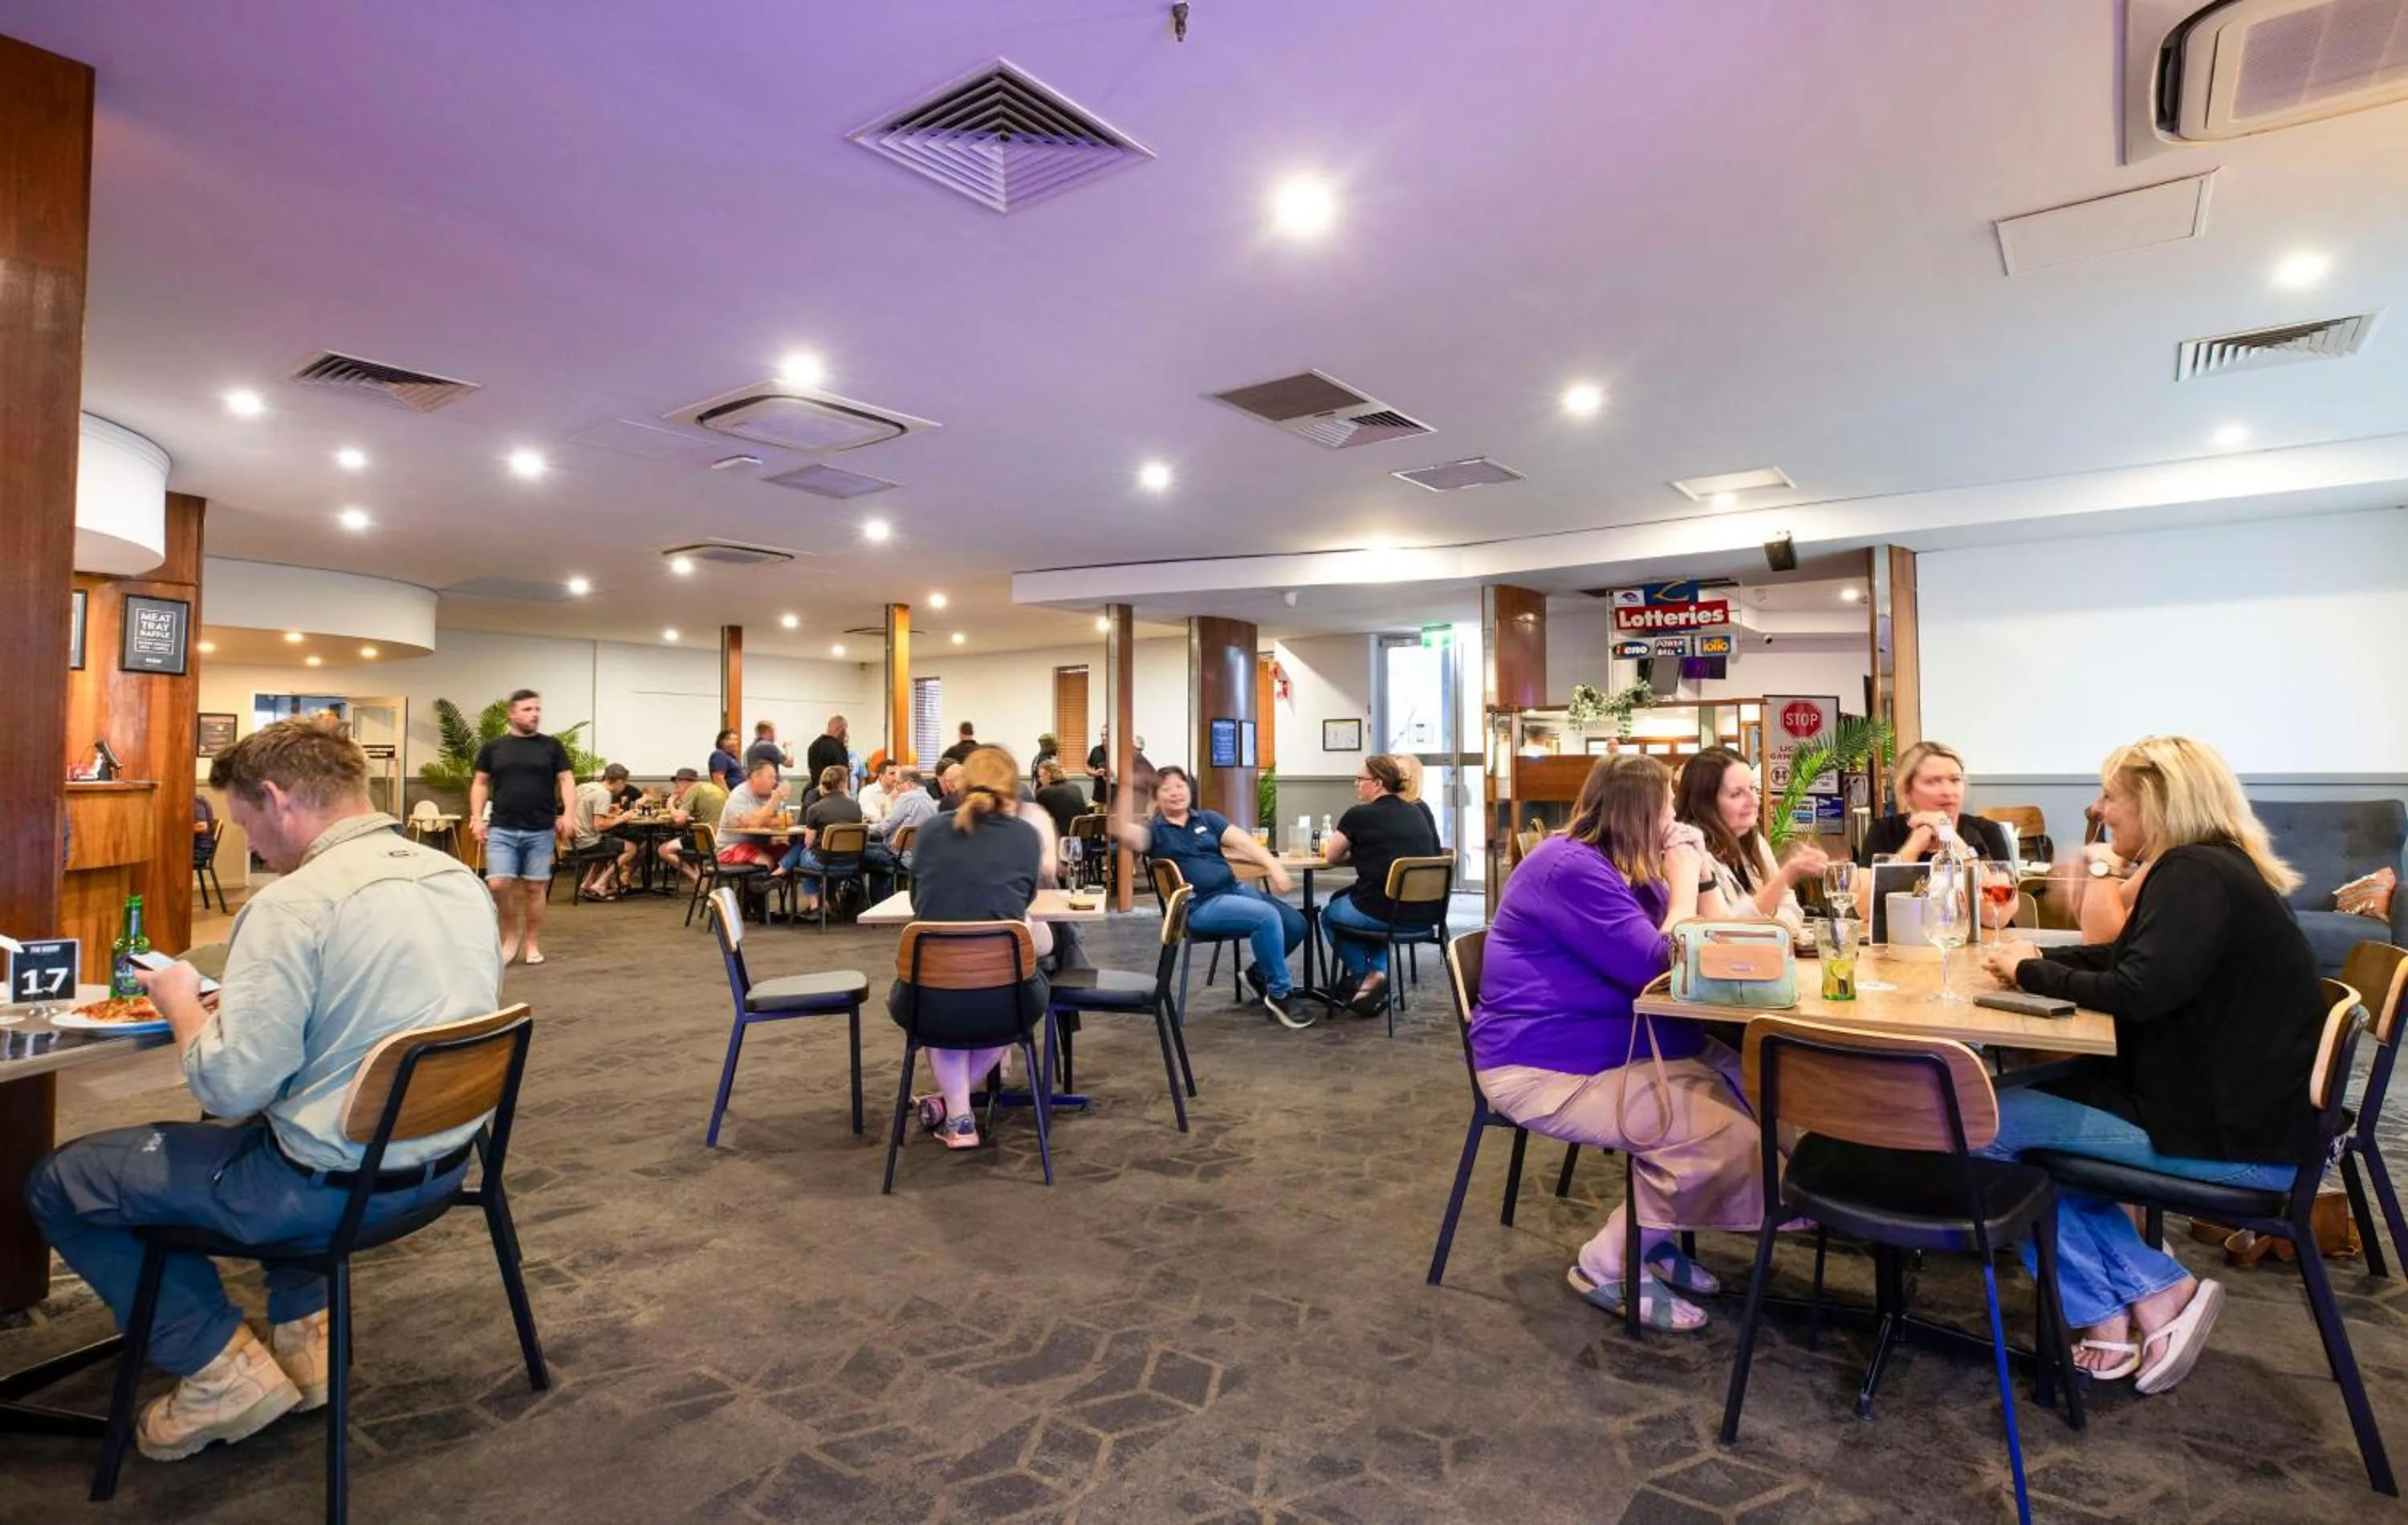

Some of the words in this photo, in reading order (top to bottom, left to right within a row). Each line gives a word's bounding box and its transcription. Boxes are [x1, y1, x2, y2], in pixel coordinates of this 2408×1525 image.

[140, 612, 171, 622] MEAT
[1619, 604, 1724, 627] Lotteries
[140, 621, 170, 631] TRAY
[1785, 712, 1818, 726] STOP
[21, 967, 69, 995] 17
